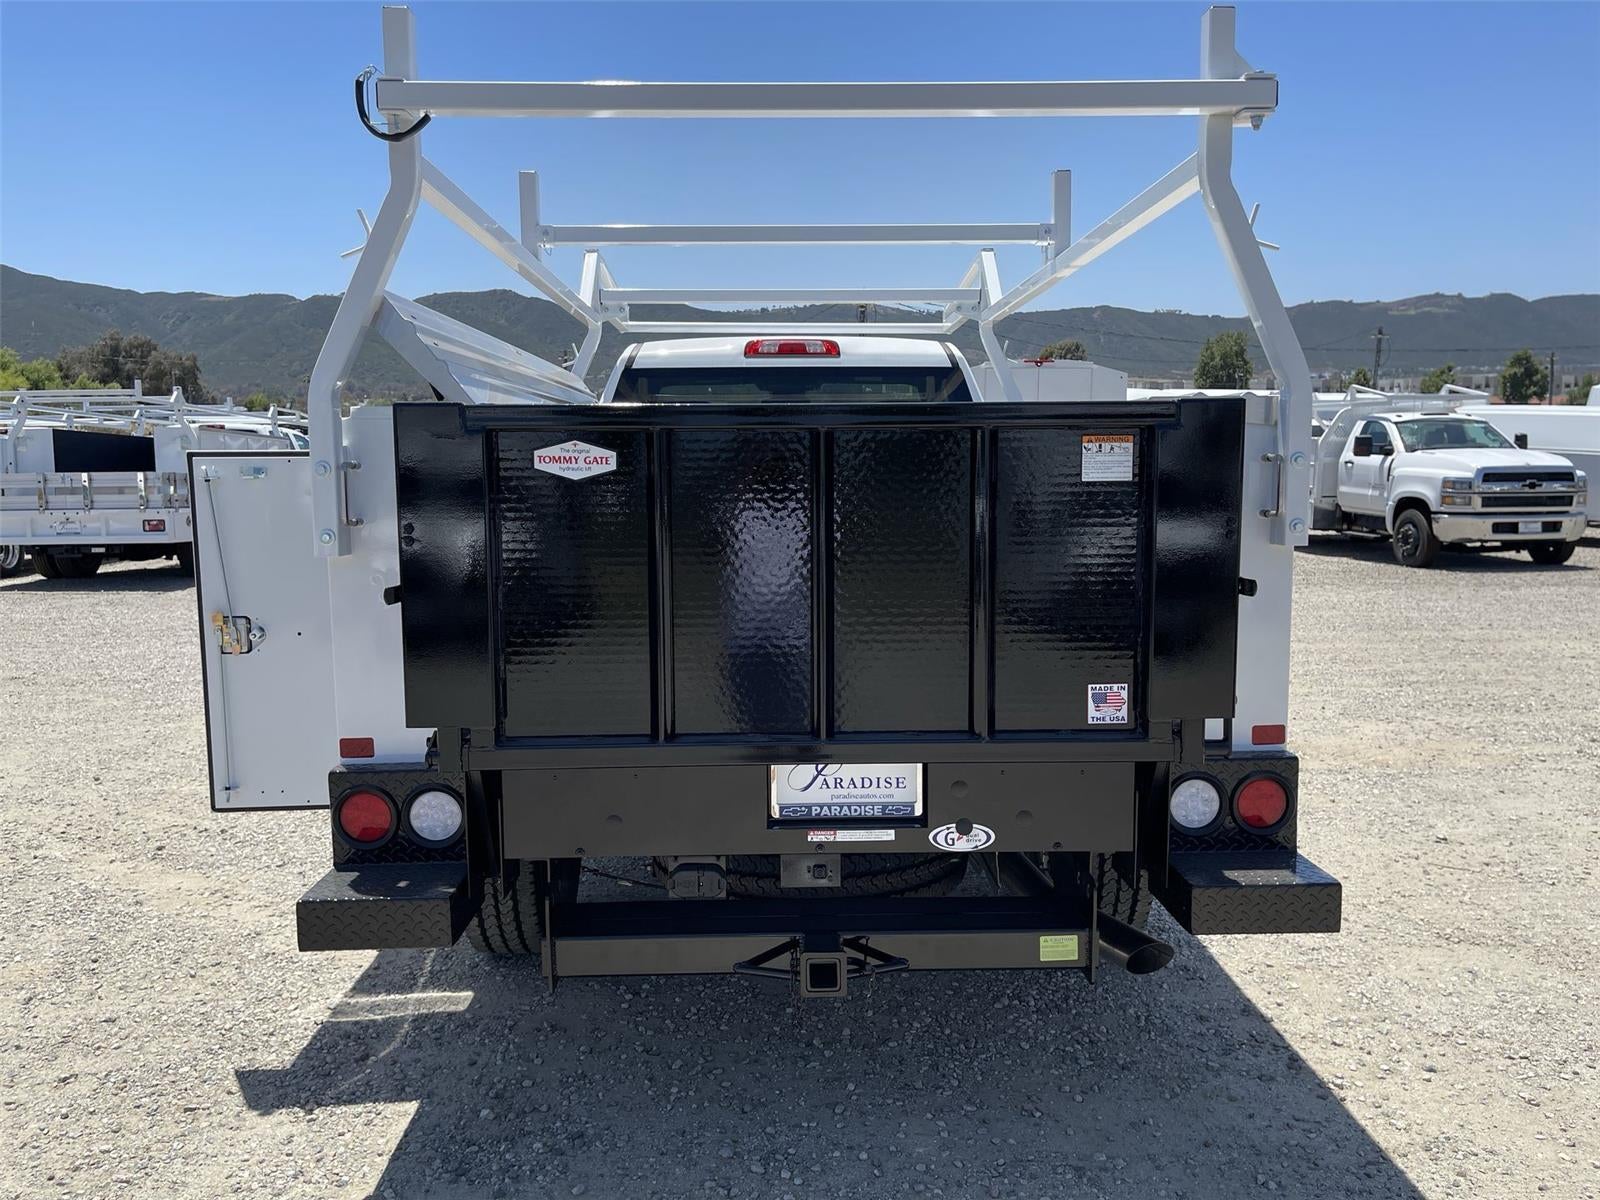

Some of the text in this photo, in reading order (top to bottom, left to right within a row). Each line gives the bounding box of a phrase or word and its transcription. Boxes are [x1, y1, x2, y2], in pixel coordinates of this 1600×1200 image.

[537, 455, 611, 465] TOMMY GATE
[830, 792, 895, 801] paradiseautos.com
[811, 806, 883, 816] PARADISE
